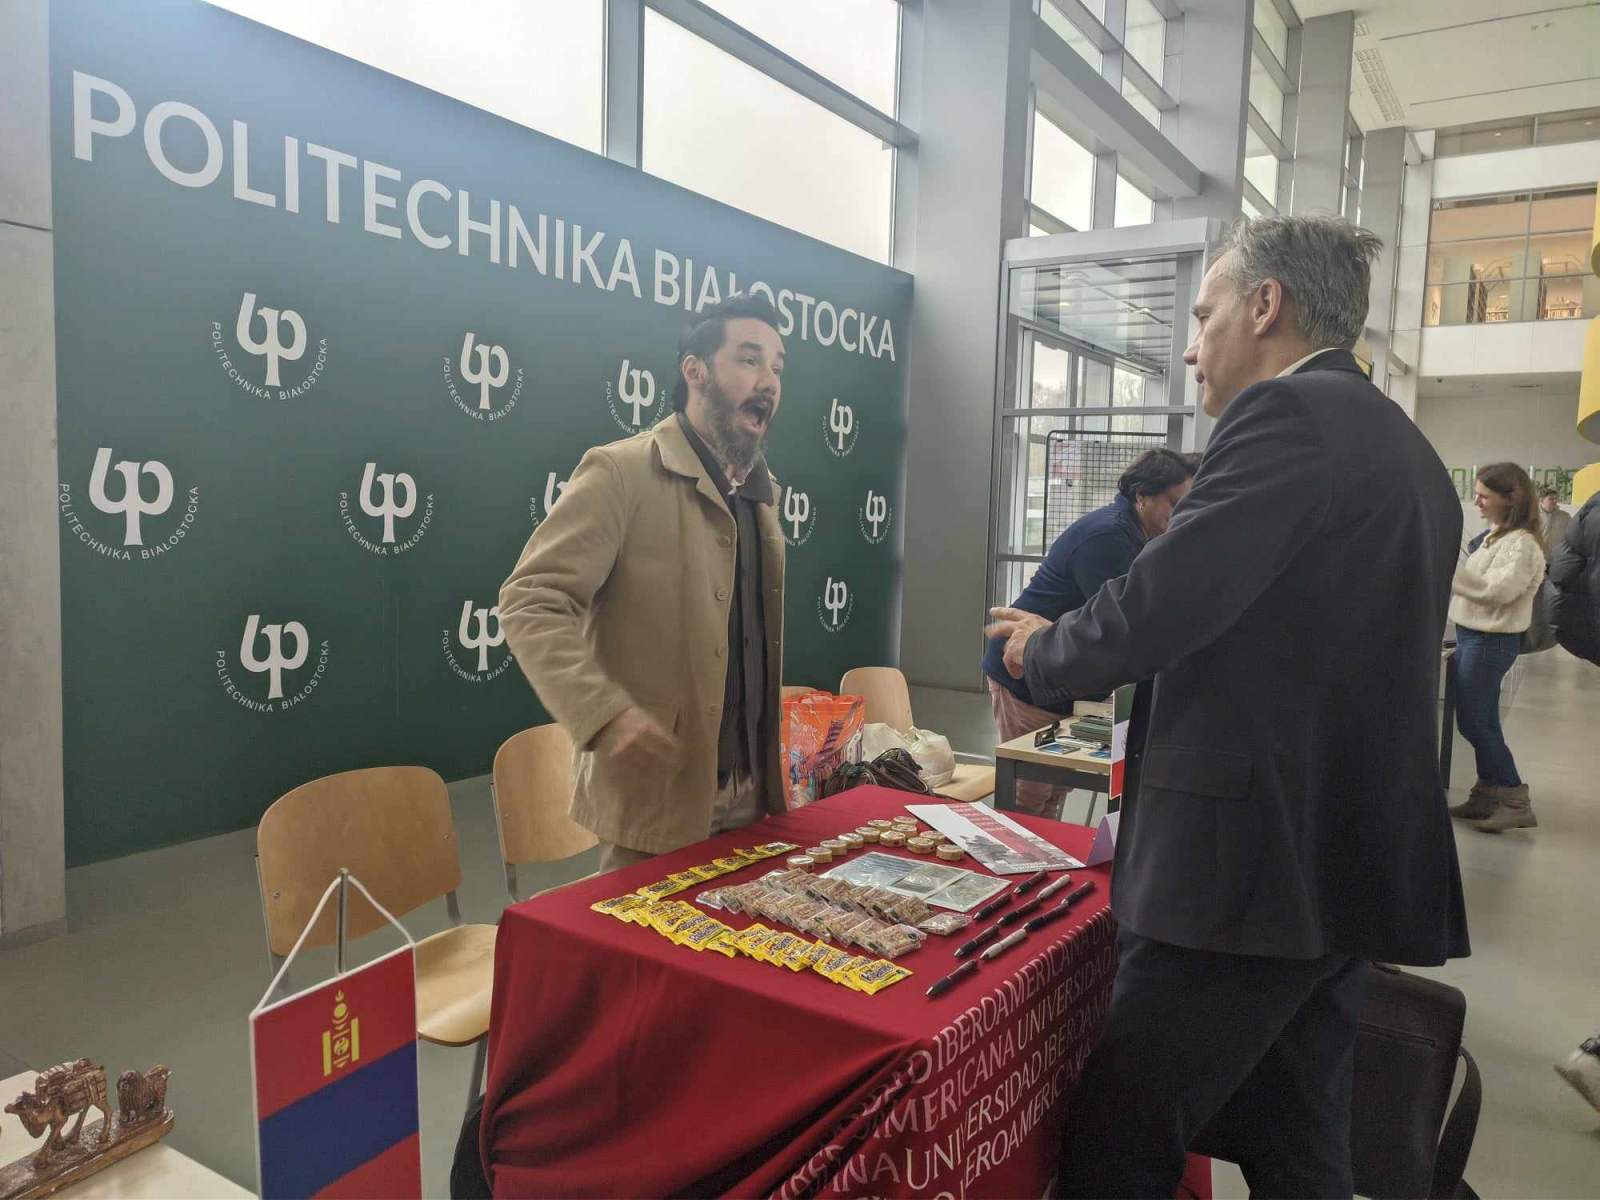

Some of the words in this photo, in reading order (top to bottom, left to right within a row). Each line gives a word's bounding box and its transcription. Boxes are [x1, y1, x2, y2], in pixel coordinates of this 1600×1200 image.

[73, 70, 642, 299] POLITECHNIKA
[212, 322, 271, 399] POLITECHNIKA
[279, 338, 328, 400] BIAŁOSTOCKA
[443, 357, 484, 421] POLITECHNIKA
[60, 483, 131, 561] POLITECHNIKA
[141, 487, 199, 560] BIAŁOSTOCKA
[339, 492, 388, 556] POLITECHNIKA
[394, 493, 434, 555] BIAŁOSTOCKA
[215, 650, 274, 713] POLITECHNIKA
[281, 639, 329, 711] BIAŁOSTOCKA
[442, 630, 482, 682] POLITECHNIKA
[905, 1050, 1043, 1191] UNIVERSIDAD
